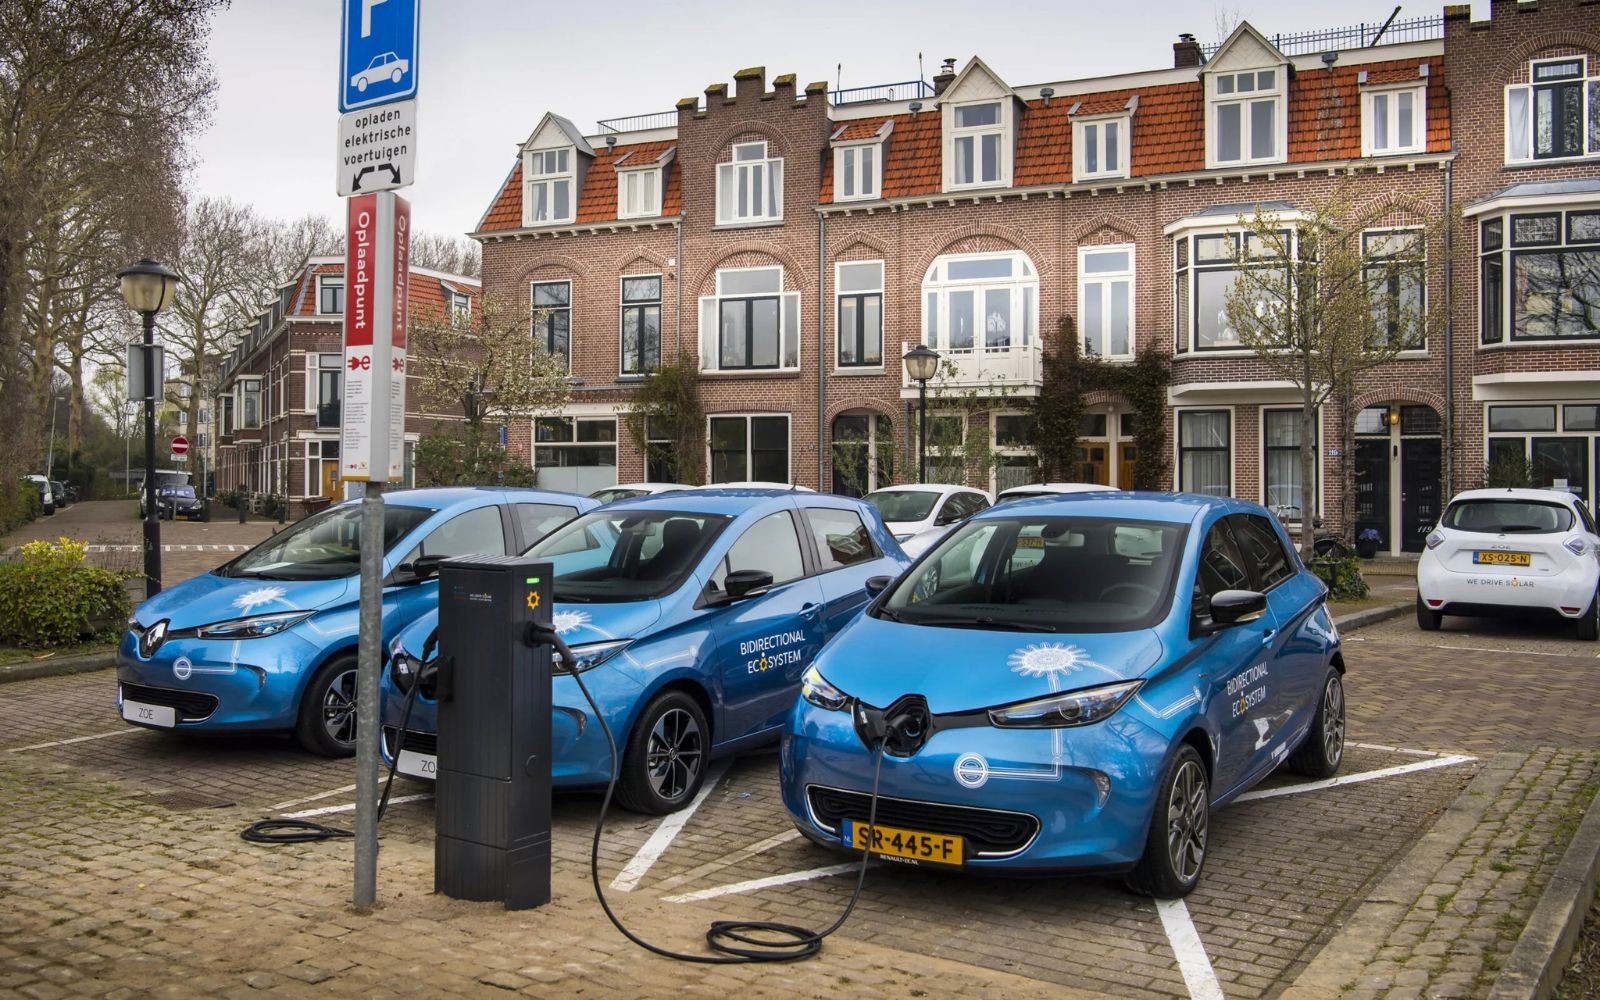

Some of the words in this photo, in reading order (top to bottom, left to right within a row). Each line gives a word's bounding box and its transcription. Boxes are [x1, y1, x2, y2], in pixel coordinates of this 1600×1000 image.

[355, 109, 400, 128] opladen
[344, 125, 411, 148] elektrische
[344, 144, 407, 166] voertuigen
[353, 211, 370, 329] Oplaadpunt
[396, 215, 406, 330] Oplaadpunt
[1482, 553, 1527, 563] XS-025-N
[1505, 579, 1535, 588] SOLAR
[740, 629, 806, 655] BIDIRECTIONAL
[747, 649, 802, 674] ECOSYSTEM
[1226, 661, 1268, 695] BIDIRECTIONAL
[138, 707, 154, 719] ZOE
[1232, 685, 1266, 717] ECOSYSTEM
[421, 759, 436, 773] ZO
[858, 826, 954, 859] SR-445-F
